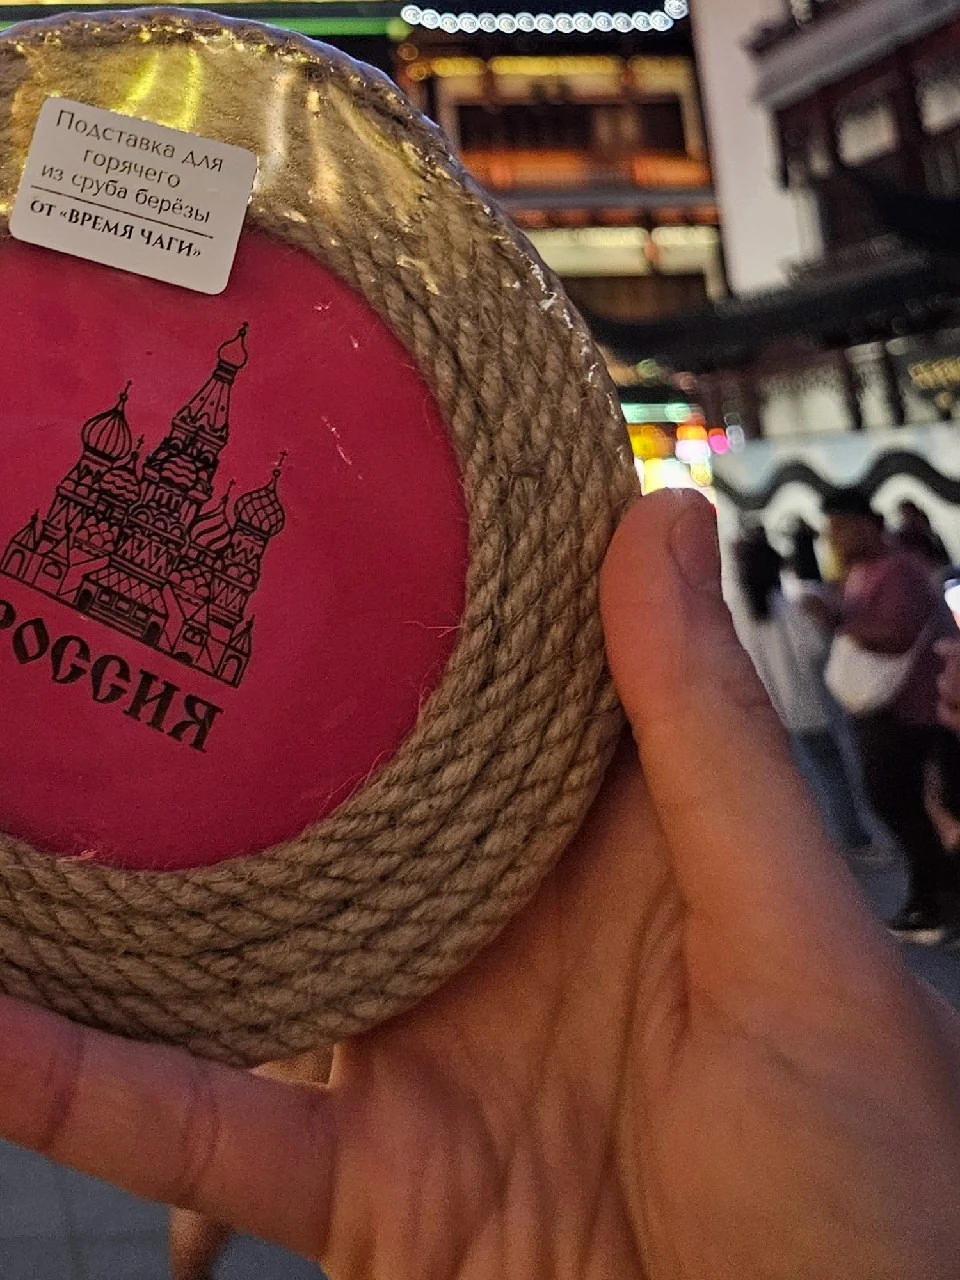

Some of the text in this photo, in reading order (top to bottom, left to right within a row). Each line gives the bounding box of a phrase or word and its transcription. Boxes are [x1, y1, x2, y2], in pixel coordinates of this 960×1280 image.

[56, 109, 225, 172] Подставка для
[83, 149, 181, 188] горячего
[41, 163, 210, 223] из сруба берёзы
[30, 200, 201, 258] ОТ «ВРЕМЯ ЧАГИ»
